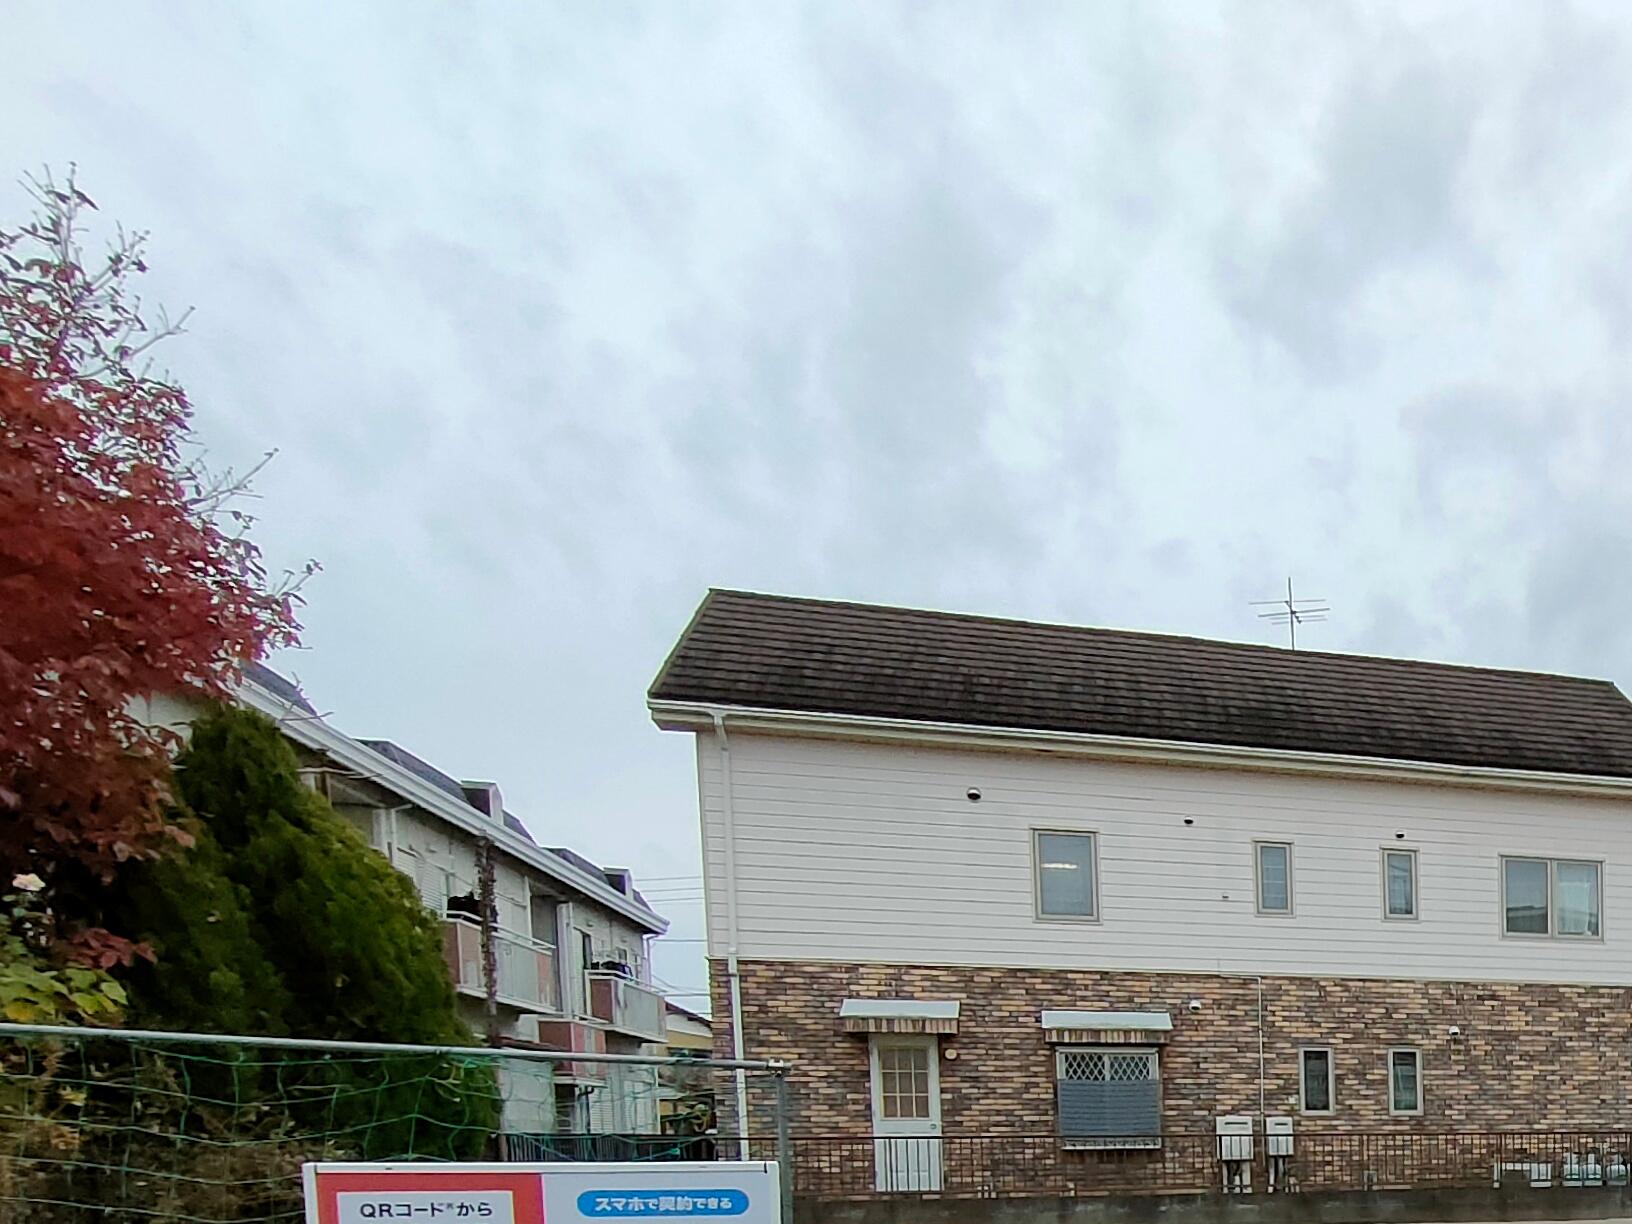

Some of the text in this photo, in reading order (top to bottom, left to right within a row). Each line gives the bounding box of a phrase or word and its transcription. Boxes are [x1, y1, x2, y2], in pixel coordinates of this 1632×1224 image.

[595, 1196, 732, 1211] スマホで契約できる
